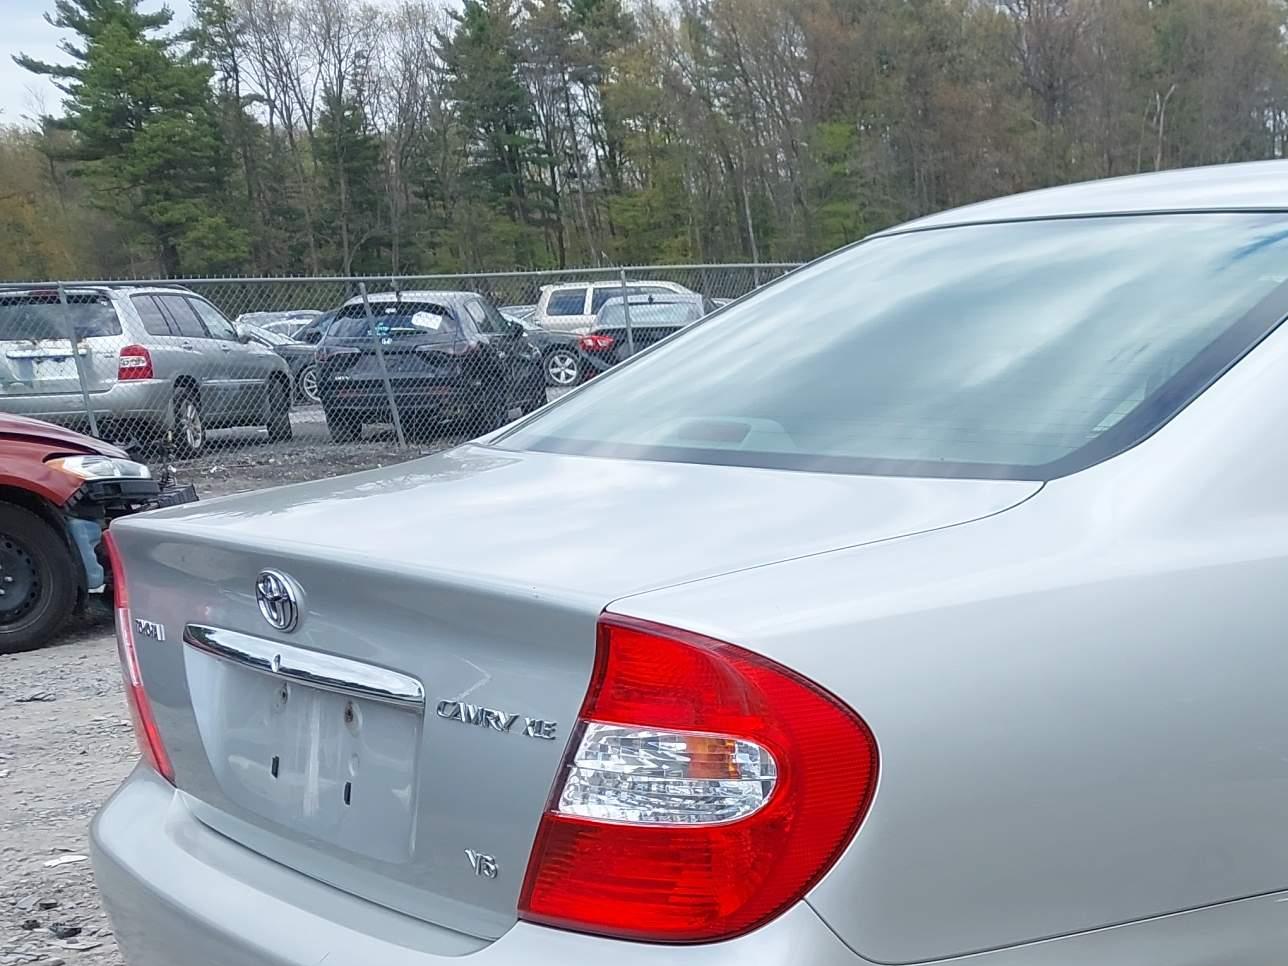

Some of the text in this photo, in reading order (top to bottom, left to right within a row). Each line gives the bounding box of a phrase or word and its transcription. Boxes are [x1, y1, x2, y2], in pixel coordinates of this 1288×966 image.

[436, 699, 558, 741] CAMRY XLE
[464, 849, 498, 879] V6
